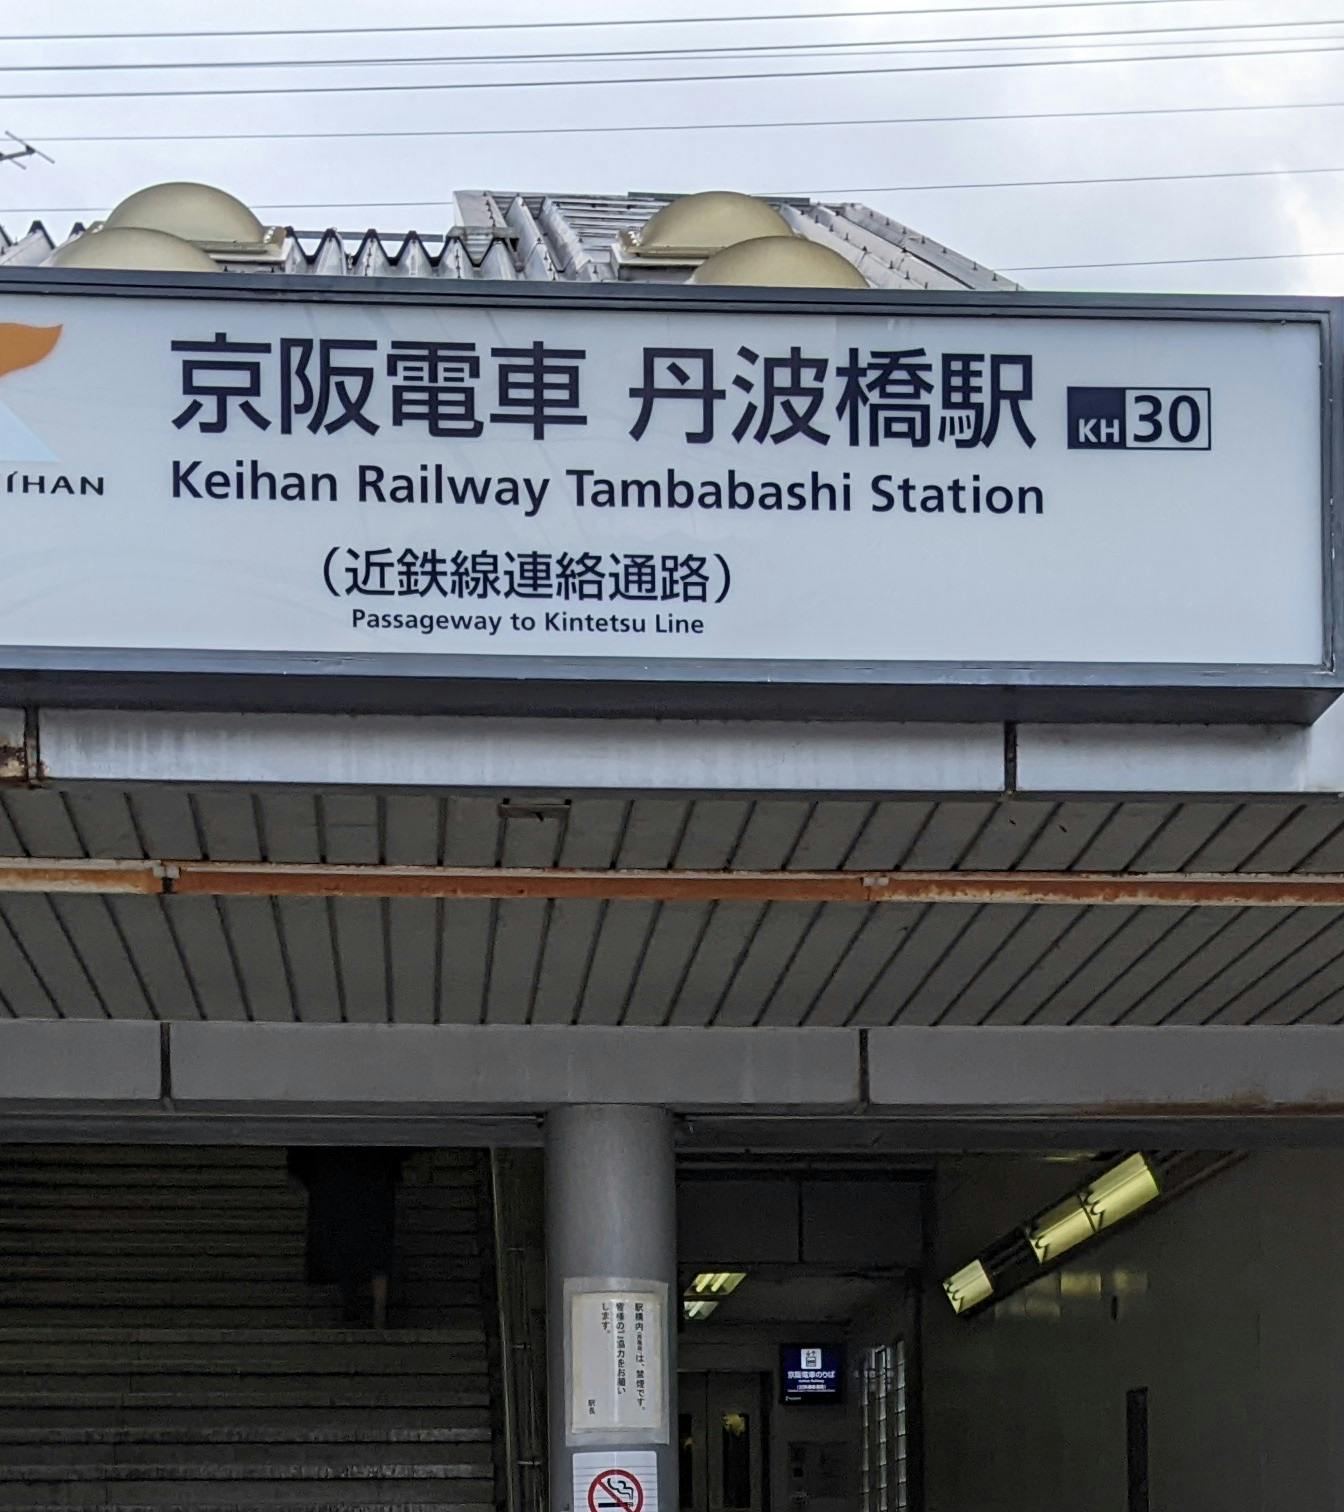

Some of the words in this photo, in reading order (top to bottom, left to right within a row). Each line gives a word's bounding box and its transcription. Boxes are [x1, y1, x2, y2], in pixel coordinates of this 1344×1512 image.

[171, 332, 588, 441] 京阪電車
[629, 346, 1036, 448] 丹波橋駅
[1078, 418, 1120, 443] KH
[1133, 394, 1201, 443] 30
[171, 460, 338, 501] Keihan
[358, 464, 550, 517] Railway
[566, 469, 851, 511] Tambabashi
[871, 473, 1044, 514] Station
[323, 546, 731, 604] （近鉄線連絡通路）
[352, 609, 502, 635] Passageway
[510, 612, 536, 632] to
[545, 612, 646, 634] Kintetsu
[656, 614, 705, 635] Line
